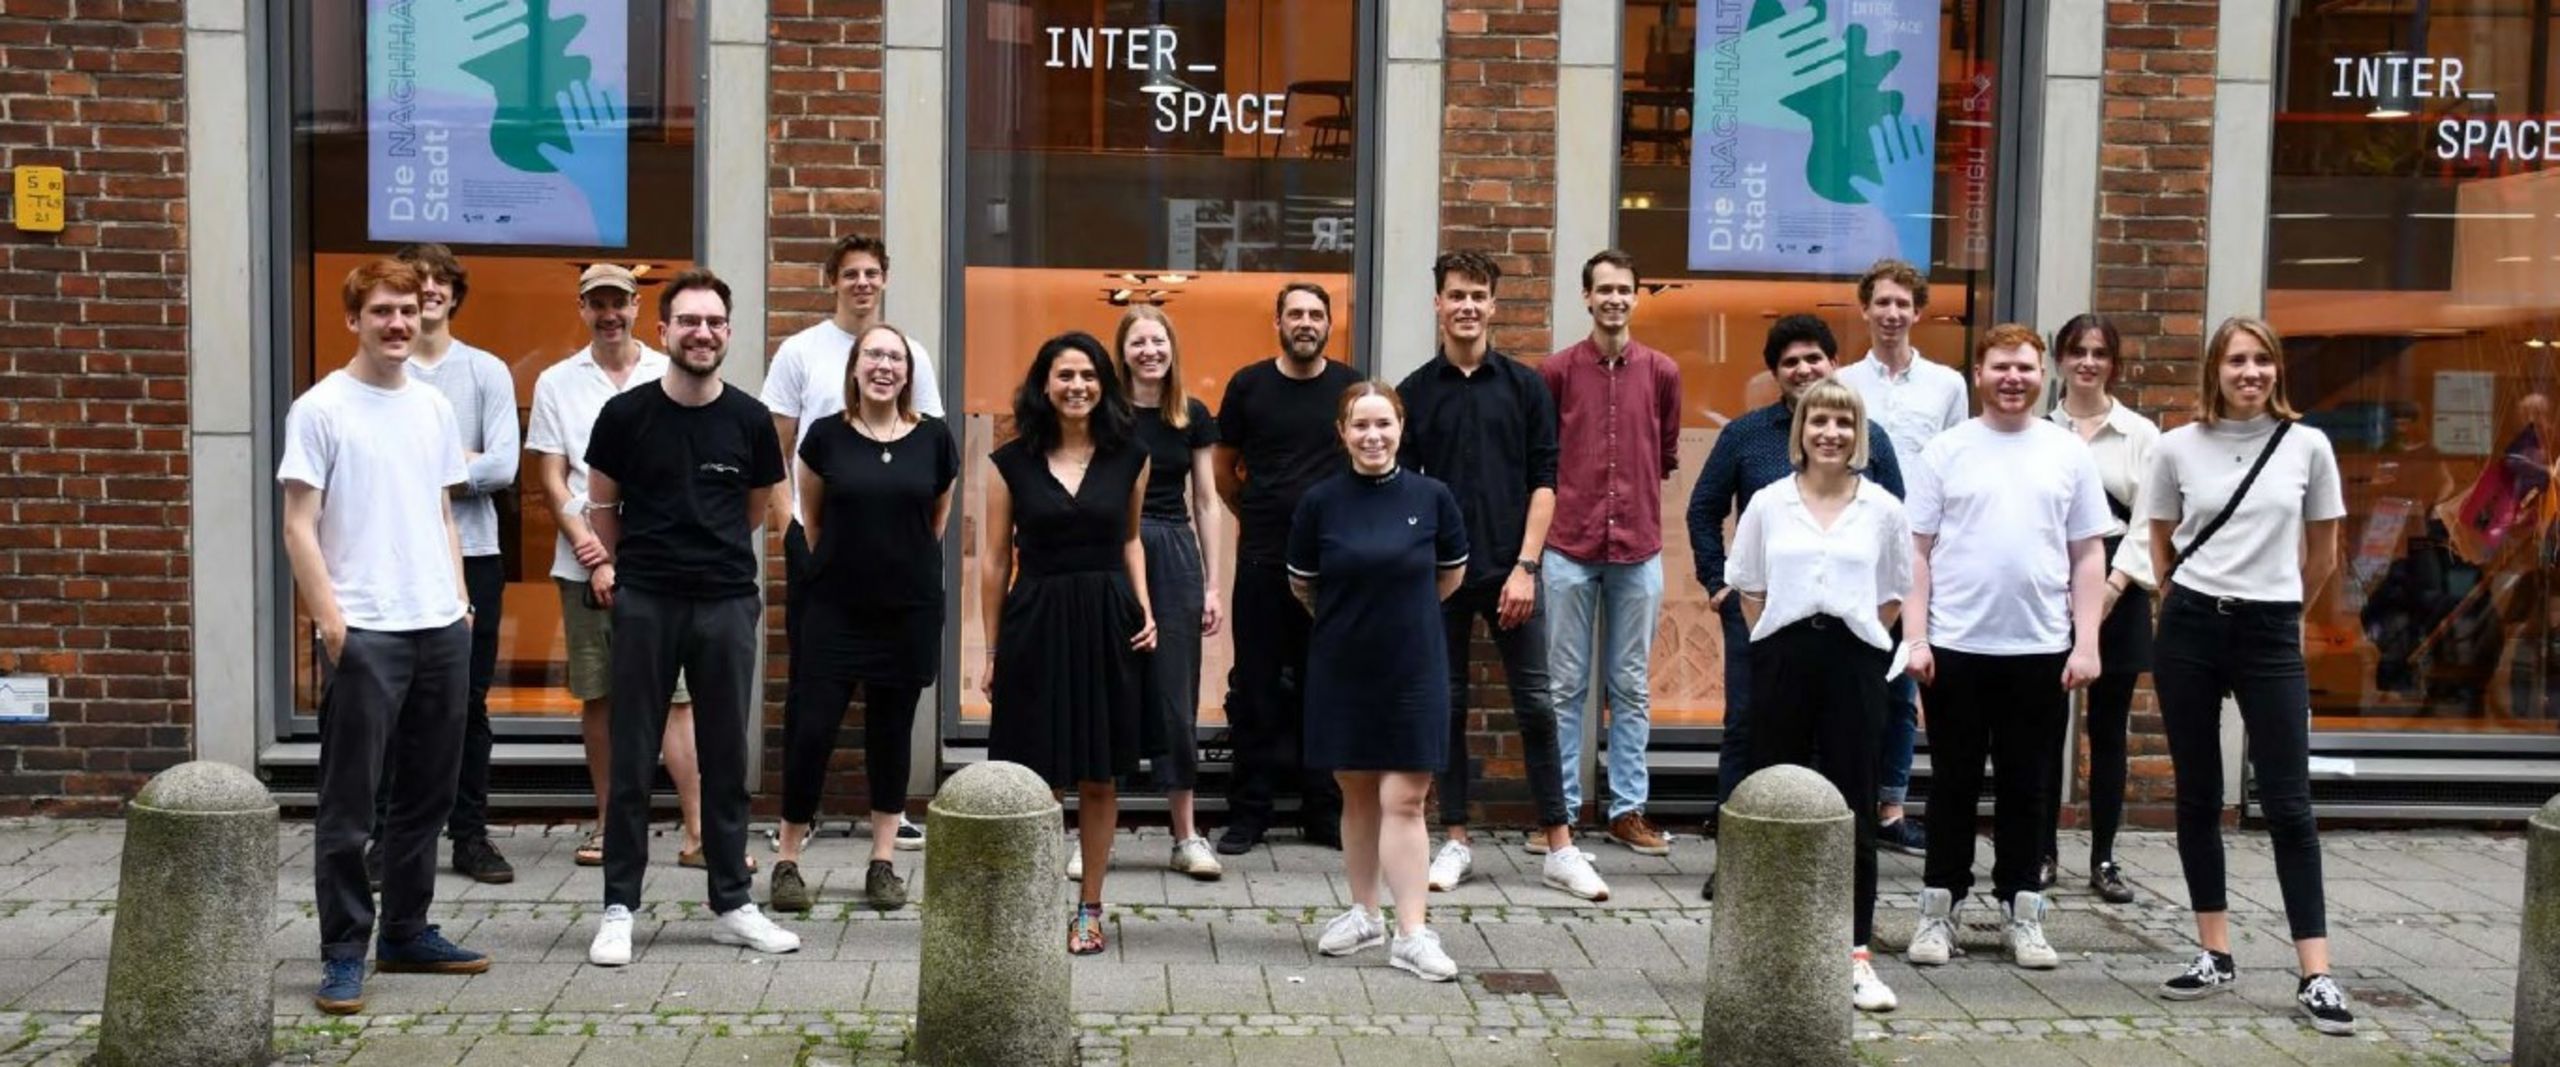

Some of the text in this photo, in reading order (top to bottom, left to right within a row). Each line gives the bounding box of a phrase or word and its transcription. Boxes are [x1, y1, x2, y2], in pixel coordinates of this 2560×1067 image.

[1155, 92, 1287, 135] SPACE
[2436, 119, 2560, 161] SPACE
[387, 165, 415, 222] Die
[422, 129, 450, 222] Stadt
[1708, 197, 1735, 252] Die
[1739, 161, 1769, 252] Stadt
